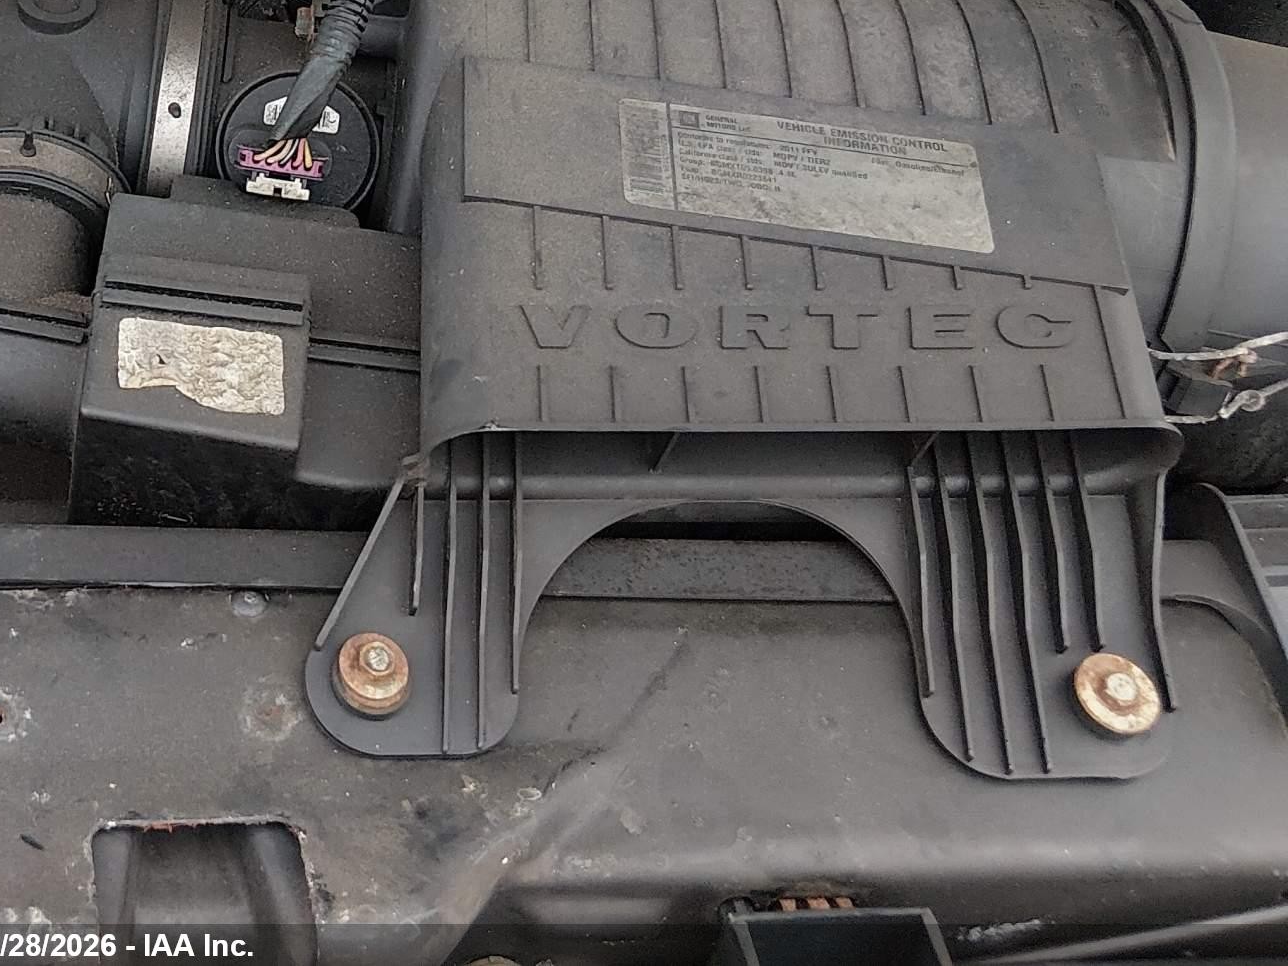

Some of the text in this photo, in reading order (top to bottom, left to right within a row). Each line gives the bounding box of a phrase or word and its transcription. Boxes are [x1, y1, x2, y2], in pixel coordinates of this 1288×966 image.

[777, 121, 948, 152] VEHICLE EMISSION CONTROL
[824, 136, 907, 155] INFORMATION
[518, 304, 1073, 350] VORTEC
